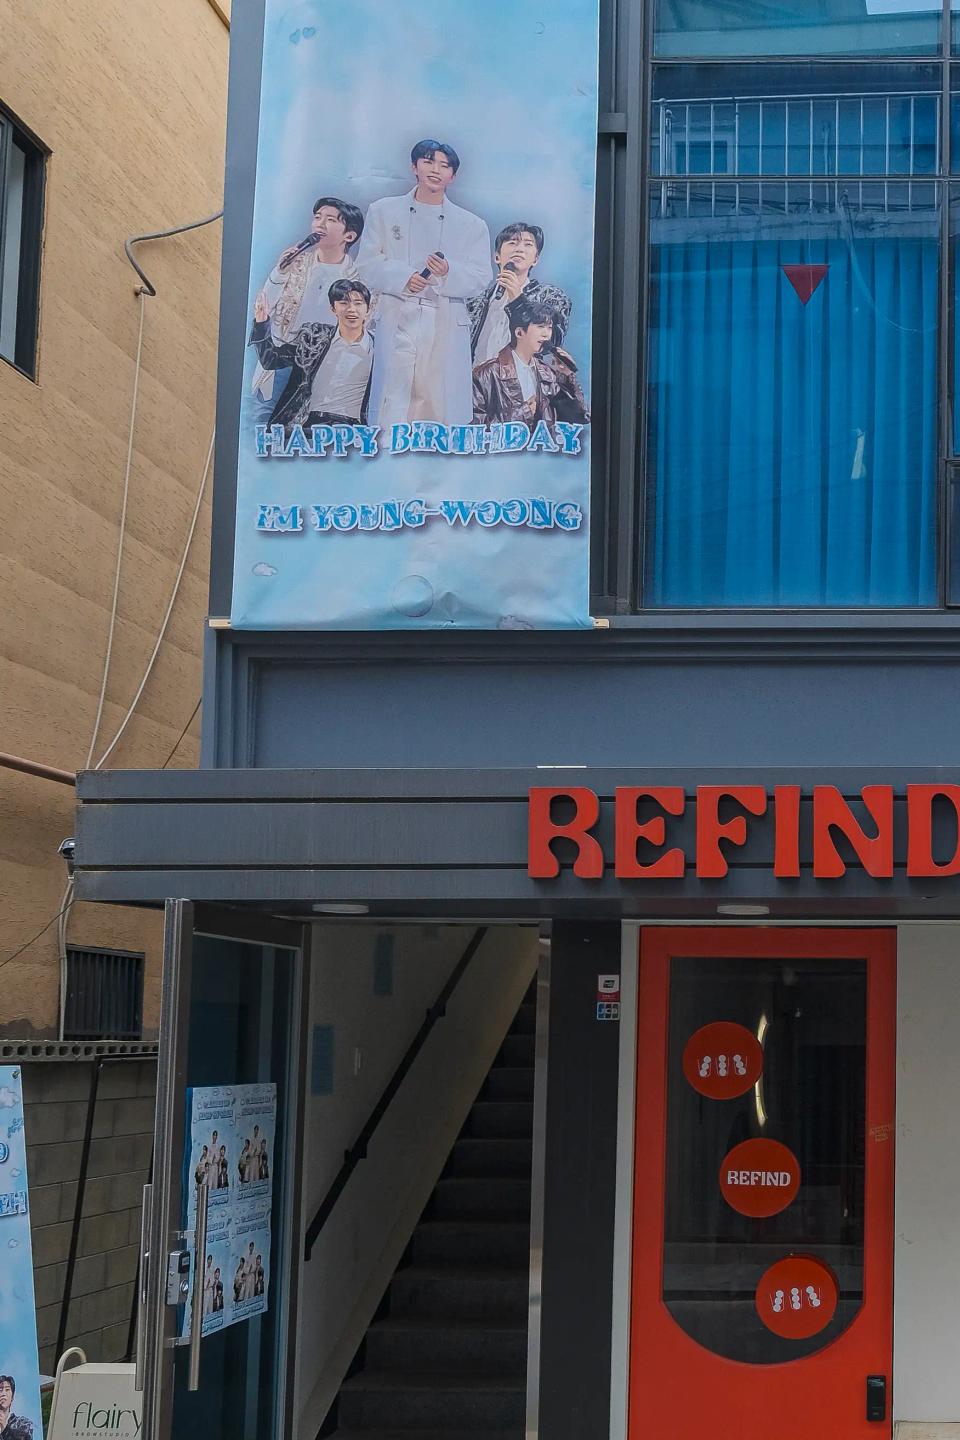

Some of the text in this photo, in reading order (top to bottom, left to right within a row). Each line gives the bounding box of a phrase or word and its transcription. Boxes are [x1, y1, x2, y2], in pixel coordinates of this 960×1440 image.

[255, 420, 583, 457] HAPPY BIRTHDAY
[727, 1170, 791, 1187] REFIND
[73, 1401, 142, 1438] flairy
